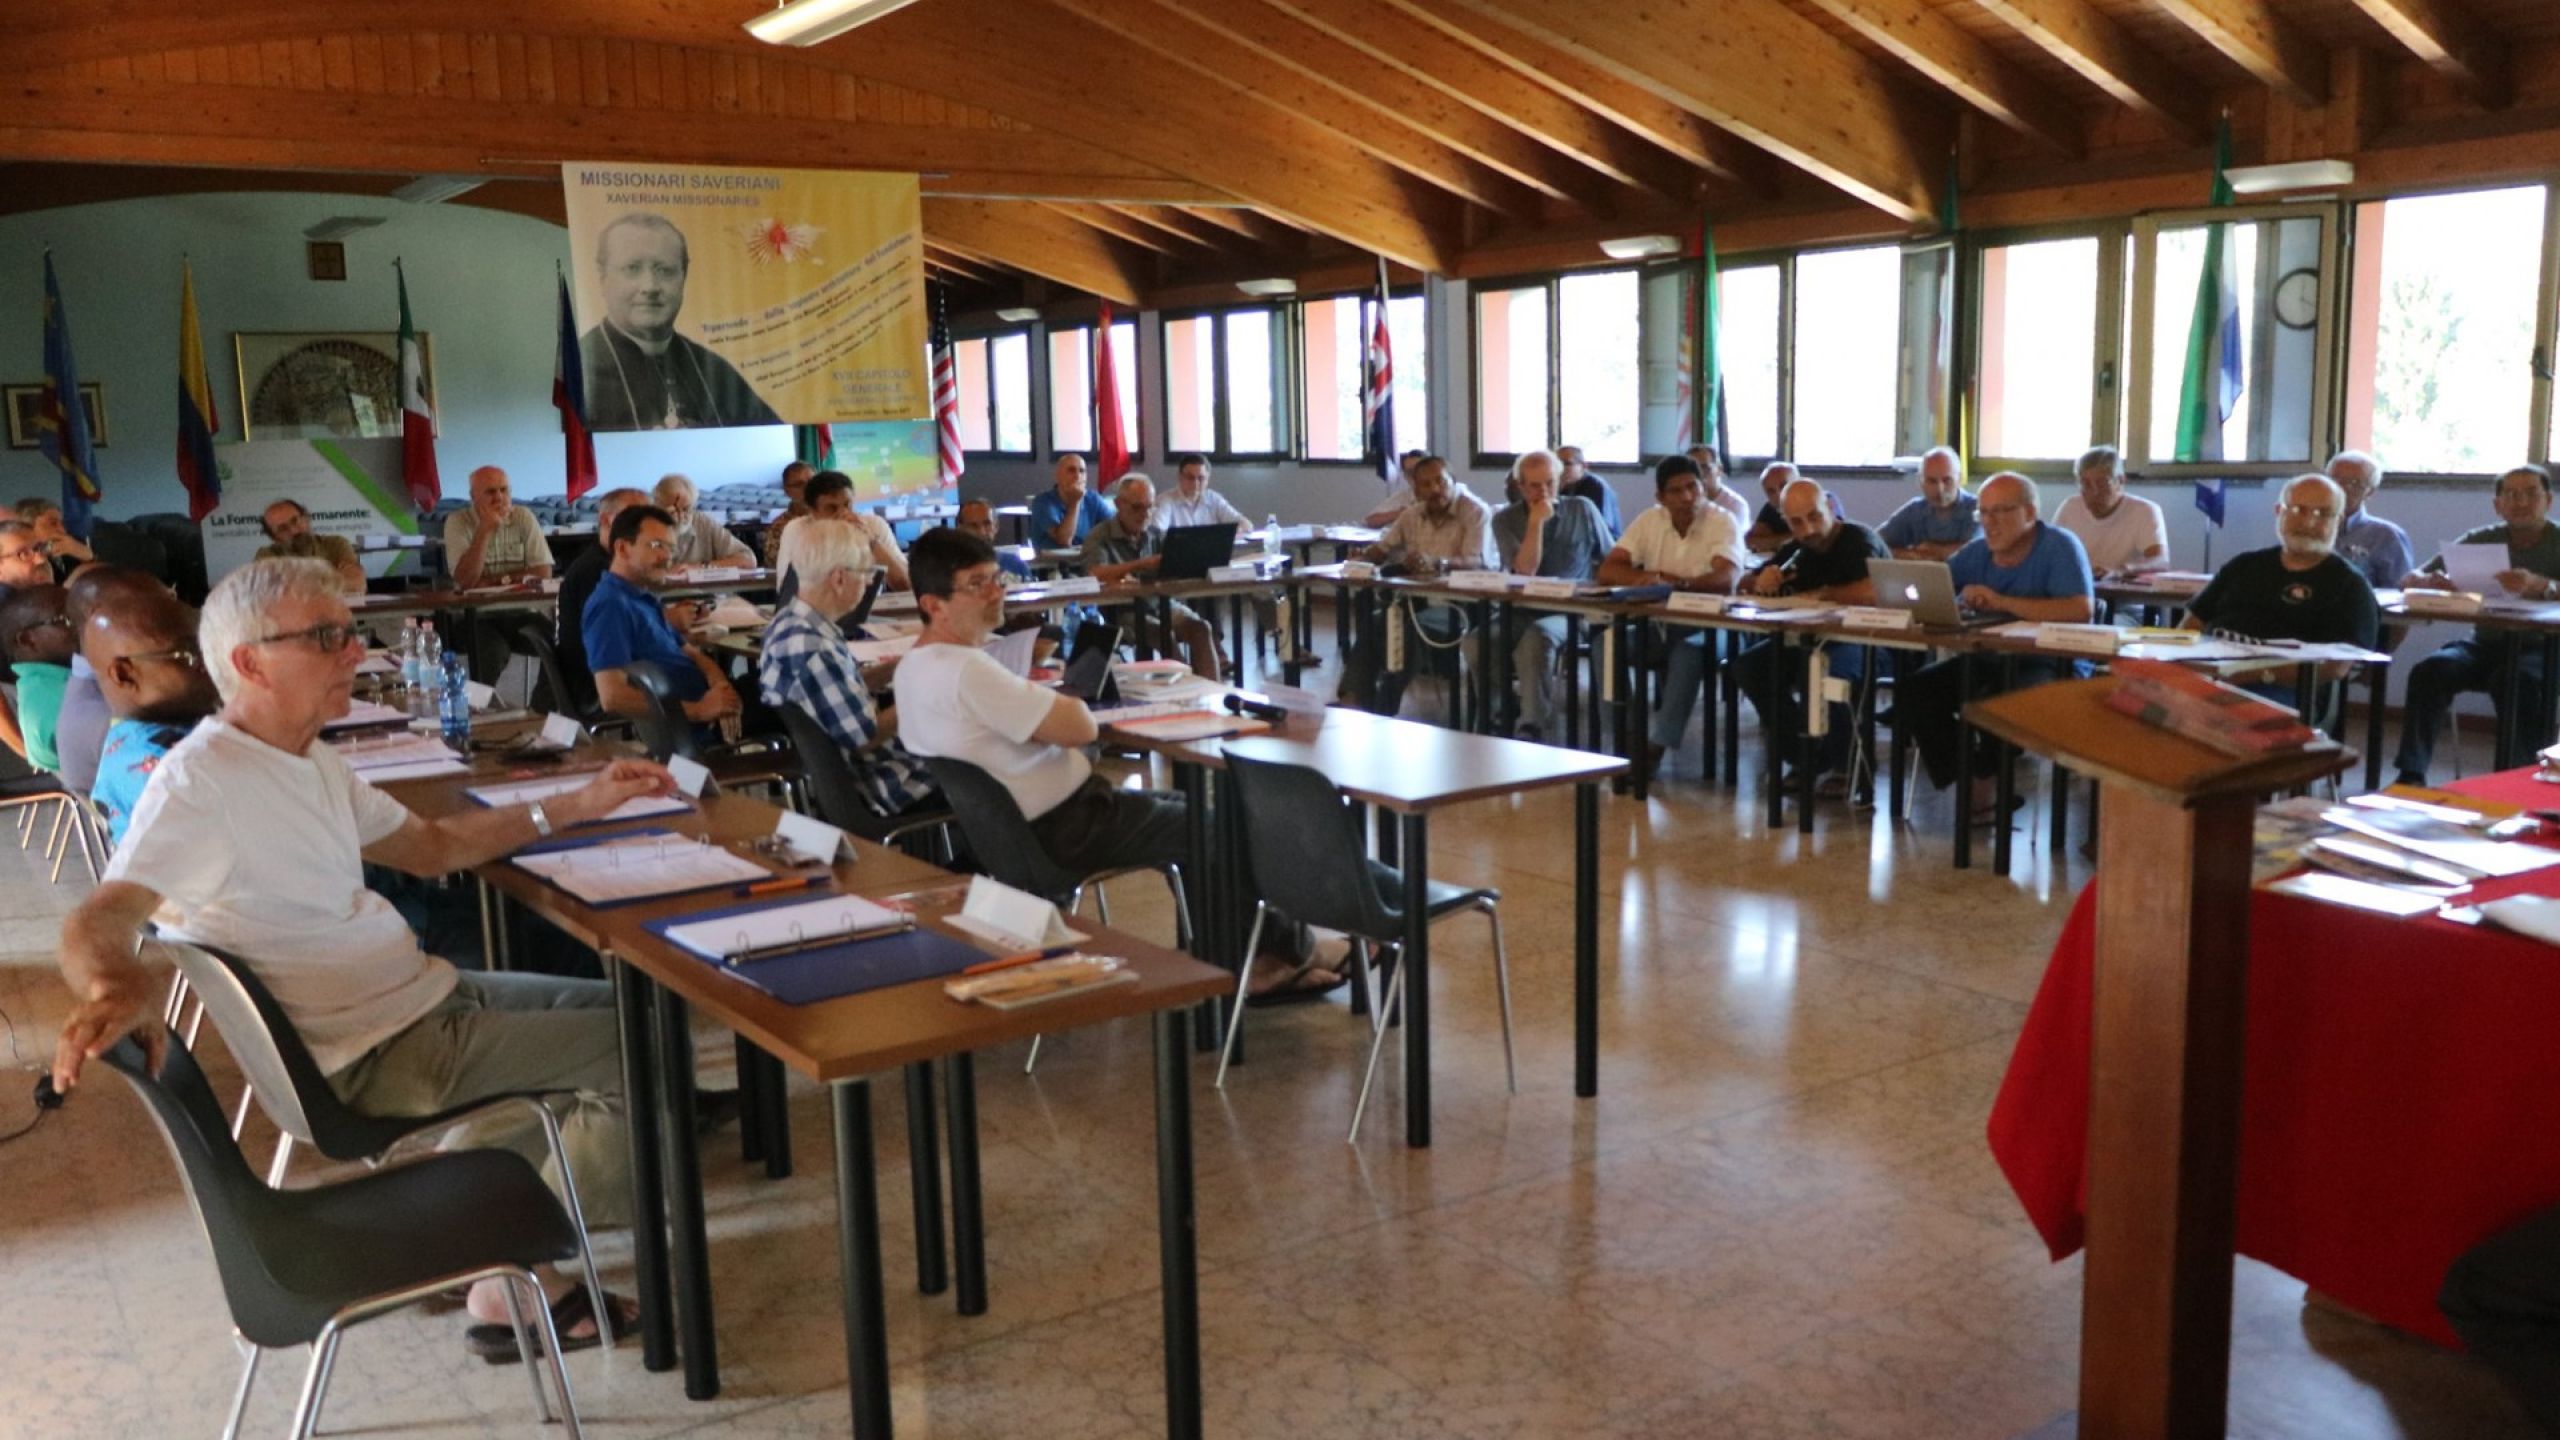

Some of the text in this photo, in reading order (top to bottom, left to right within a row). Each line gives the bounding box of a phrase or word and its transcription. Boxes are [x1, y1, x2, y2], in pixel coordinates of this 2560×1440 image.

[580, 171, 781, 191] MISSIONARI SAVERIANI
[606, 192, 760, 208] XAVERIAN MISSIONARIES
[209, 515, 225, 527] La
